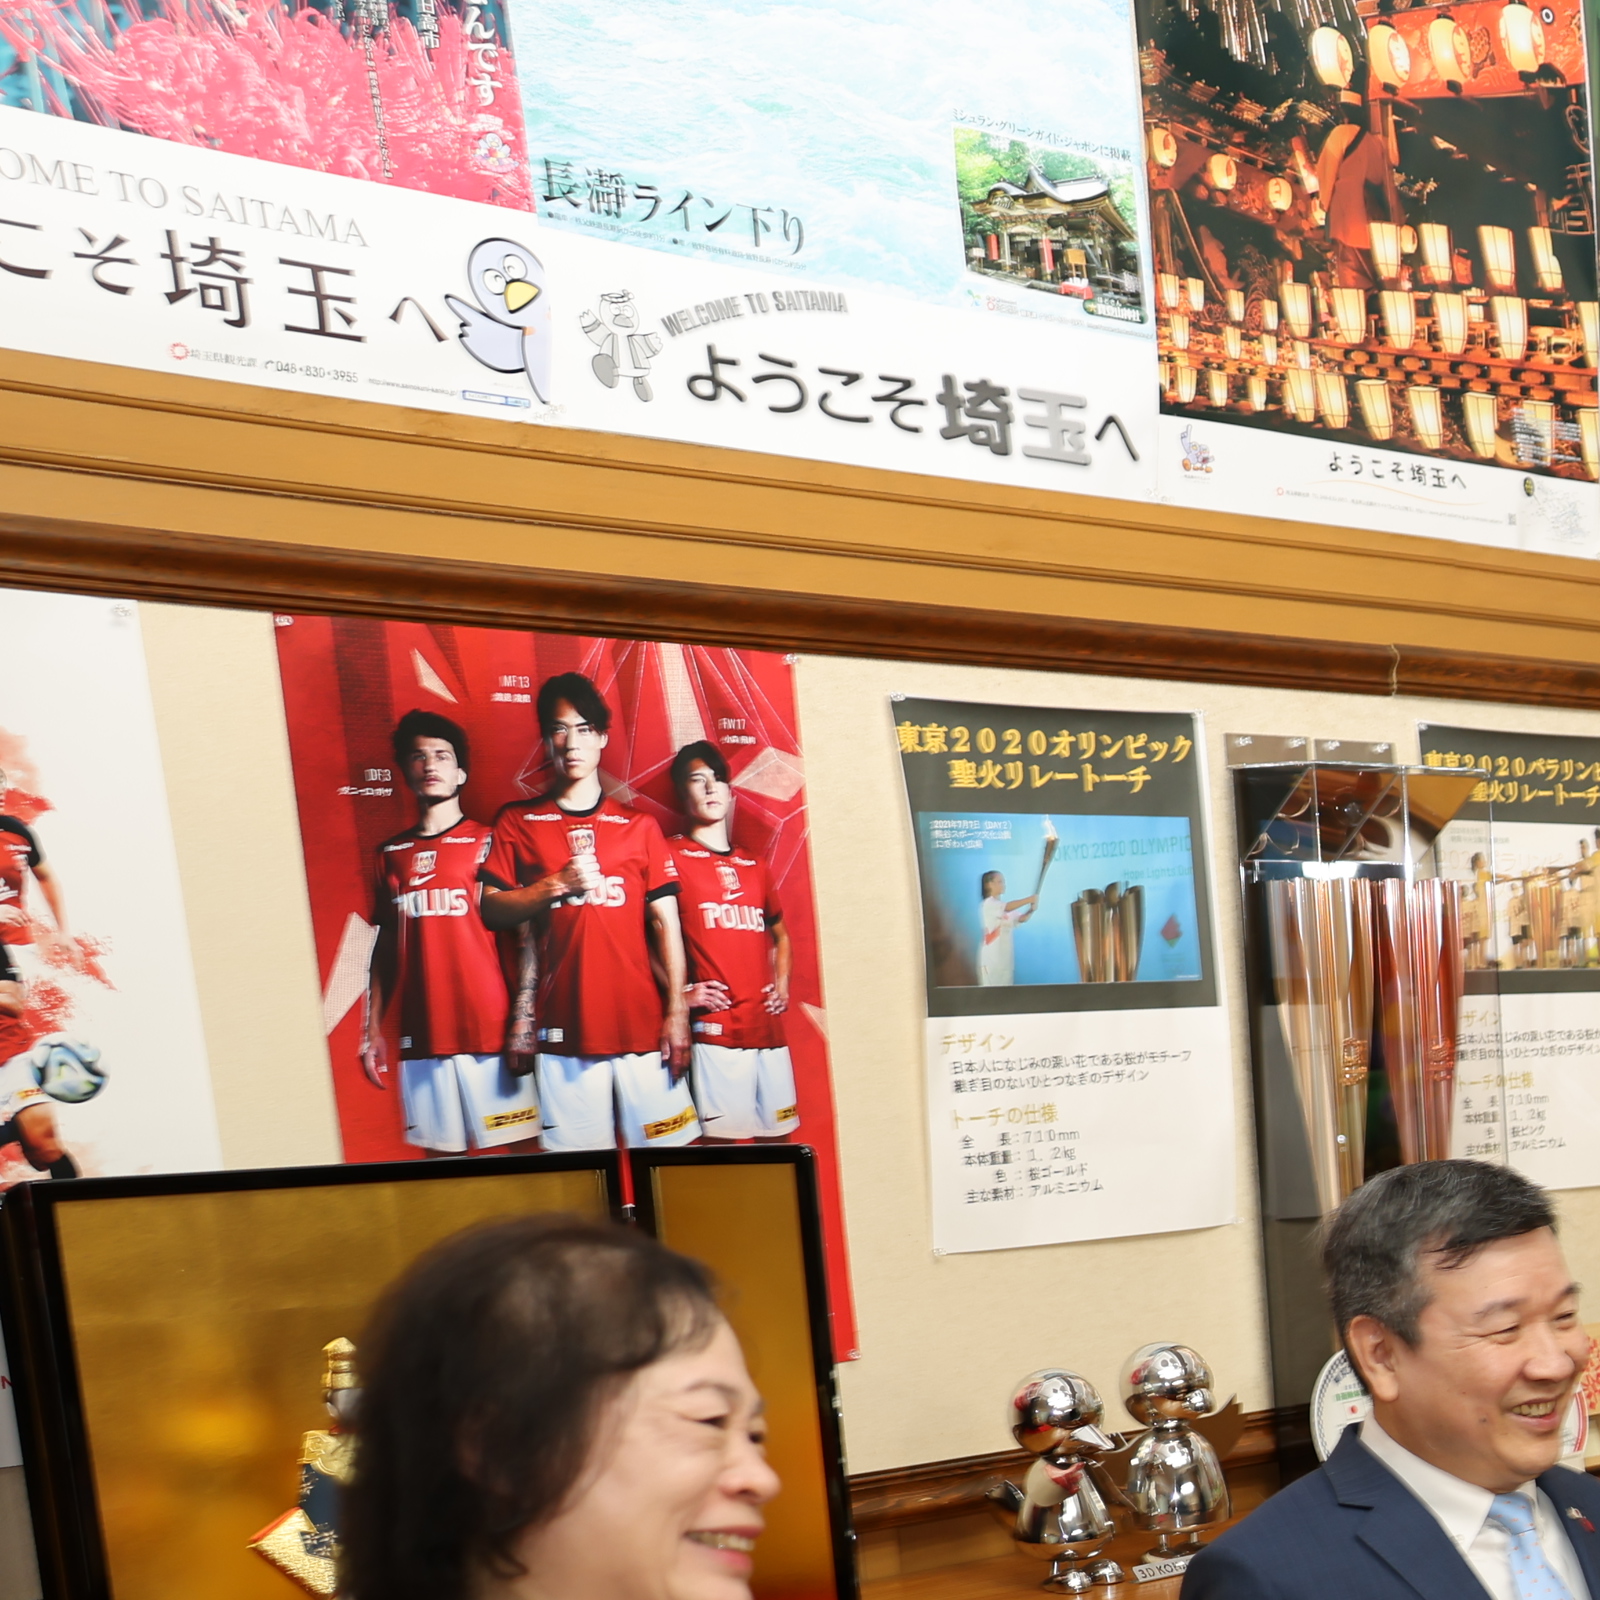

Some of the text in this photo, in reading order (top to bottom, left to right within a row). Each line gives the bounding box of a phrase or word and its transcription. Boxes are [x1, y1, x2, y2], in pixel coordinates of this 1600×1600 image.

[463, 0, 503, 107] んです
[109, 169, 170, 209] TO
[181, 184, 371, 248] SAITAMA
[660, 289, 849, 338] WELCOME TO SAITAMA
[686, 342, 1140, 465] ようこそ埼玉へ
[1328, 451, 1468, 490] ようこそ埼玉へ
[947, 758, 1151, 793] 聖火リレートーチ
[698, 901, 766, 932] POLUS
[1459, 1010, 1503, 1028] ザイン
[940, 1033, 1015, 1056] デザイン
[952, 1102, 1060, 1130] トーチの仕様
[1138, 1567, 1156, 1579] 3D
